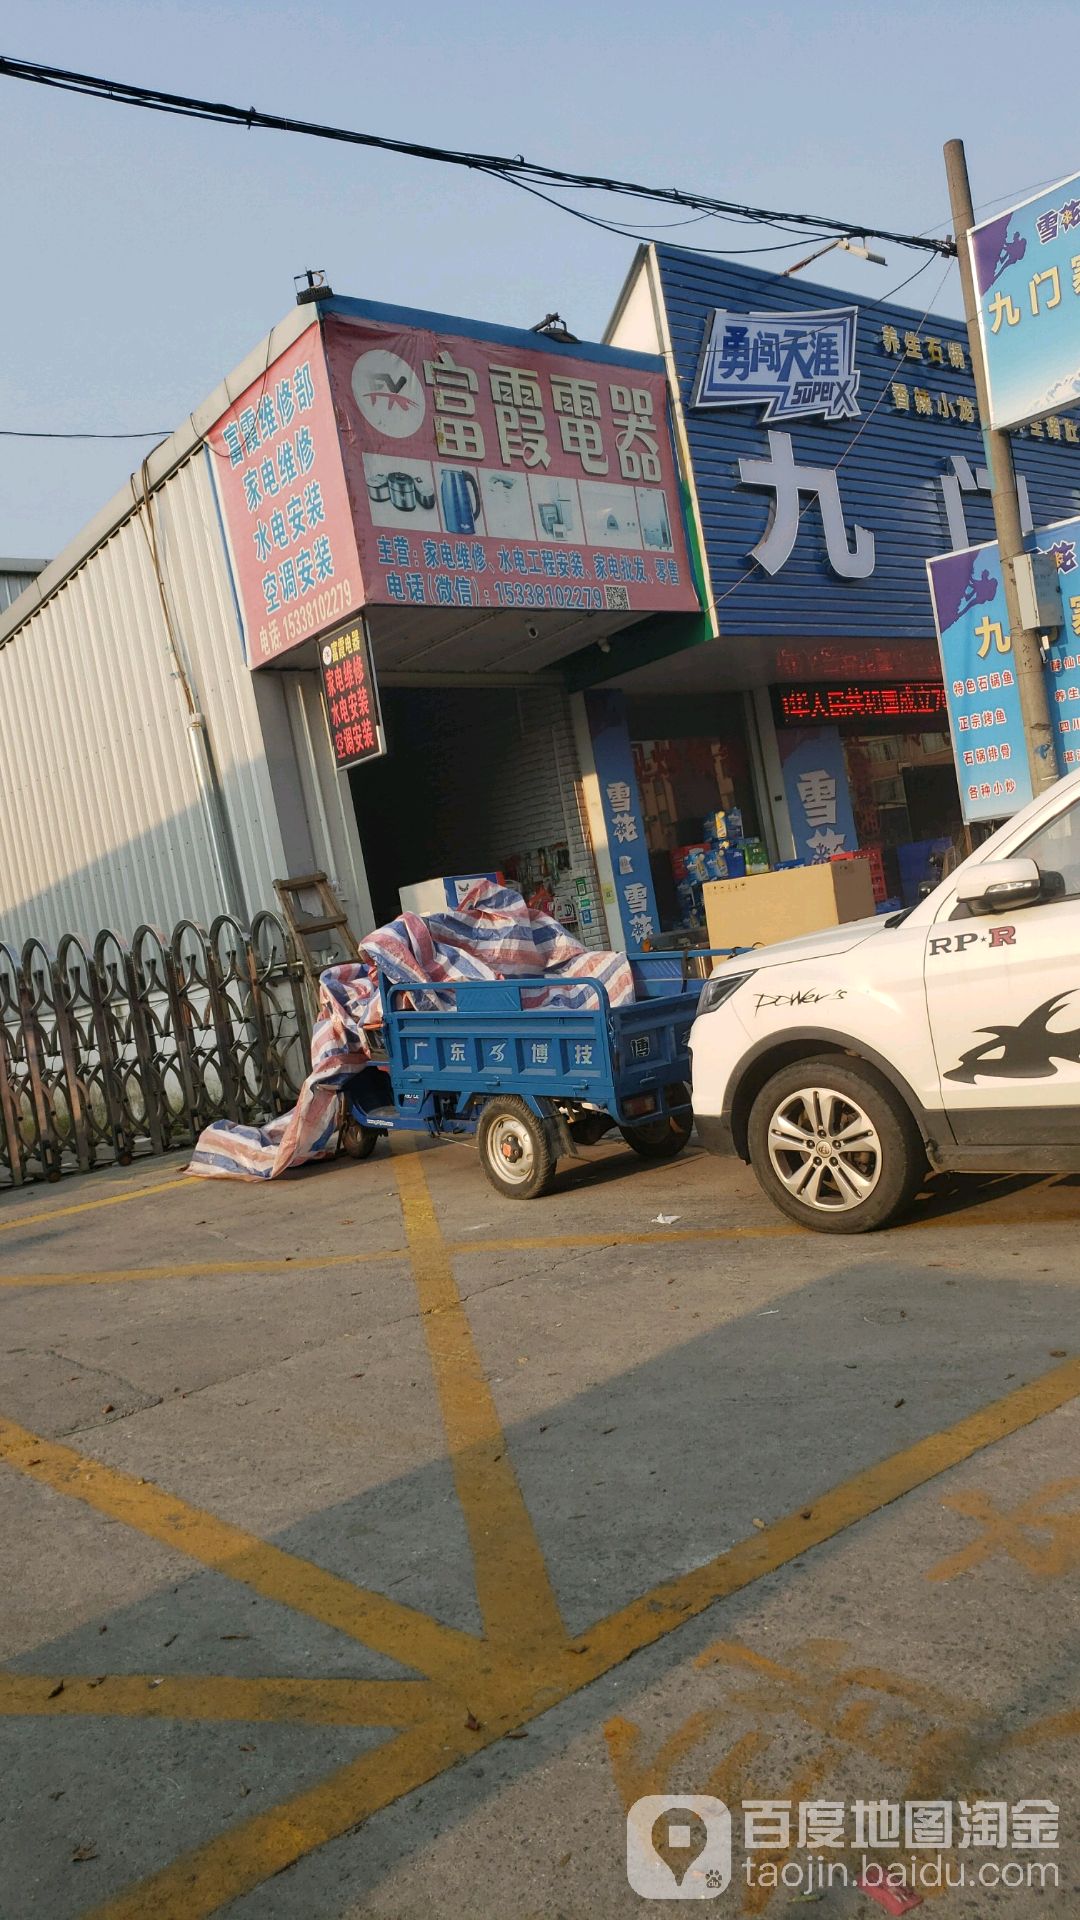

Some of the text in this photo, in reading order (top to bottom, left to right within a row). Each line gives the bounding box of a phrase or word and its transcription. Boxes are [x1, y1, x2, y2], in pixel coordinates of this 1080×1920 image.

[718, 325, 839, 382] 勇闯天涯
[222, 360, 315, 469] 富霞维修部
[242, 425, 316, 512] 家电维修
[252, 479, 326, 562] 水电安装
[262, 534, 334, 615] 空调安装
[325, 655, 364, 697] 家电维修
[953, 669, 1015, 697] 特色石锅鱼
[331, 686, 369, 728] 水电安装
[958, 708, 1007, 732] 正宗烤鱼
[335, 718, 374, 759] 空调安装
[963, 744, 1012, 766] 石锅排骨
[968, 778, 1016, 801] 各种小炒
[606, 781, 639, 844] 雪花
[623, 882, 654, 945] 雪花
